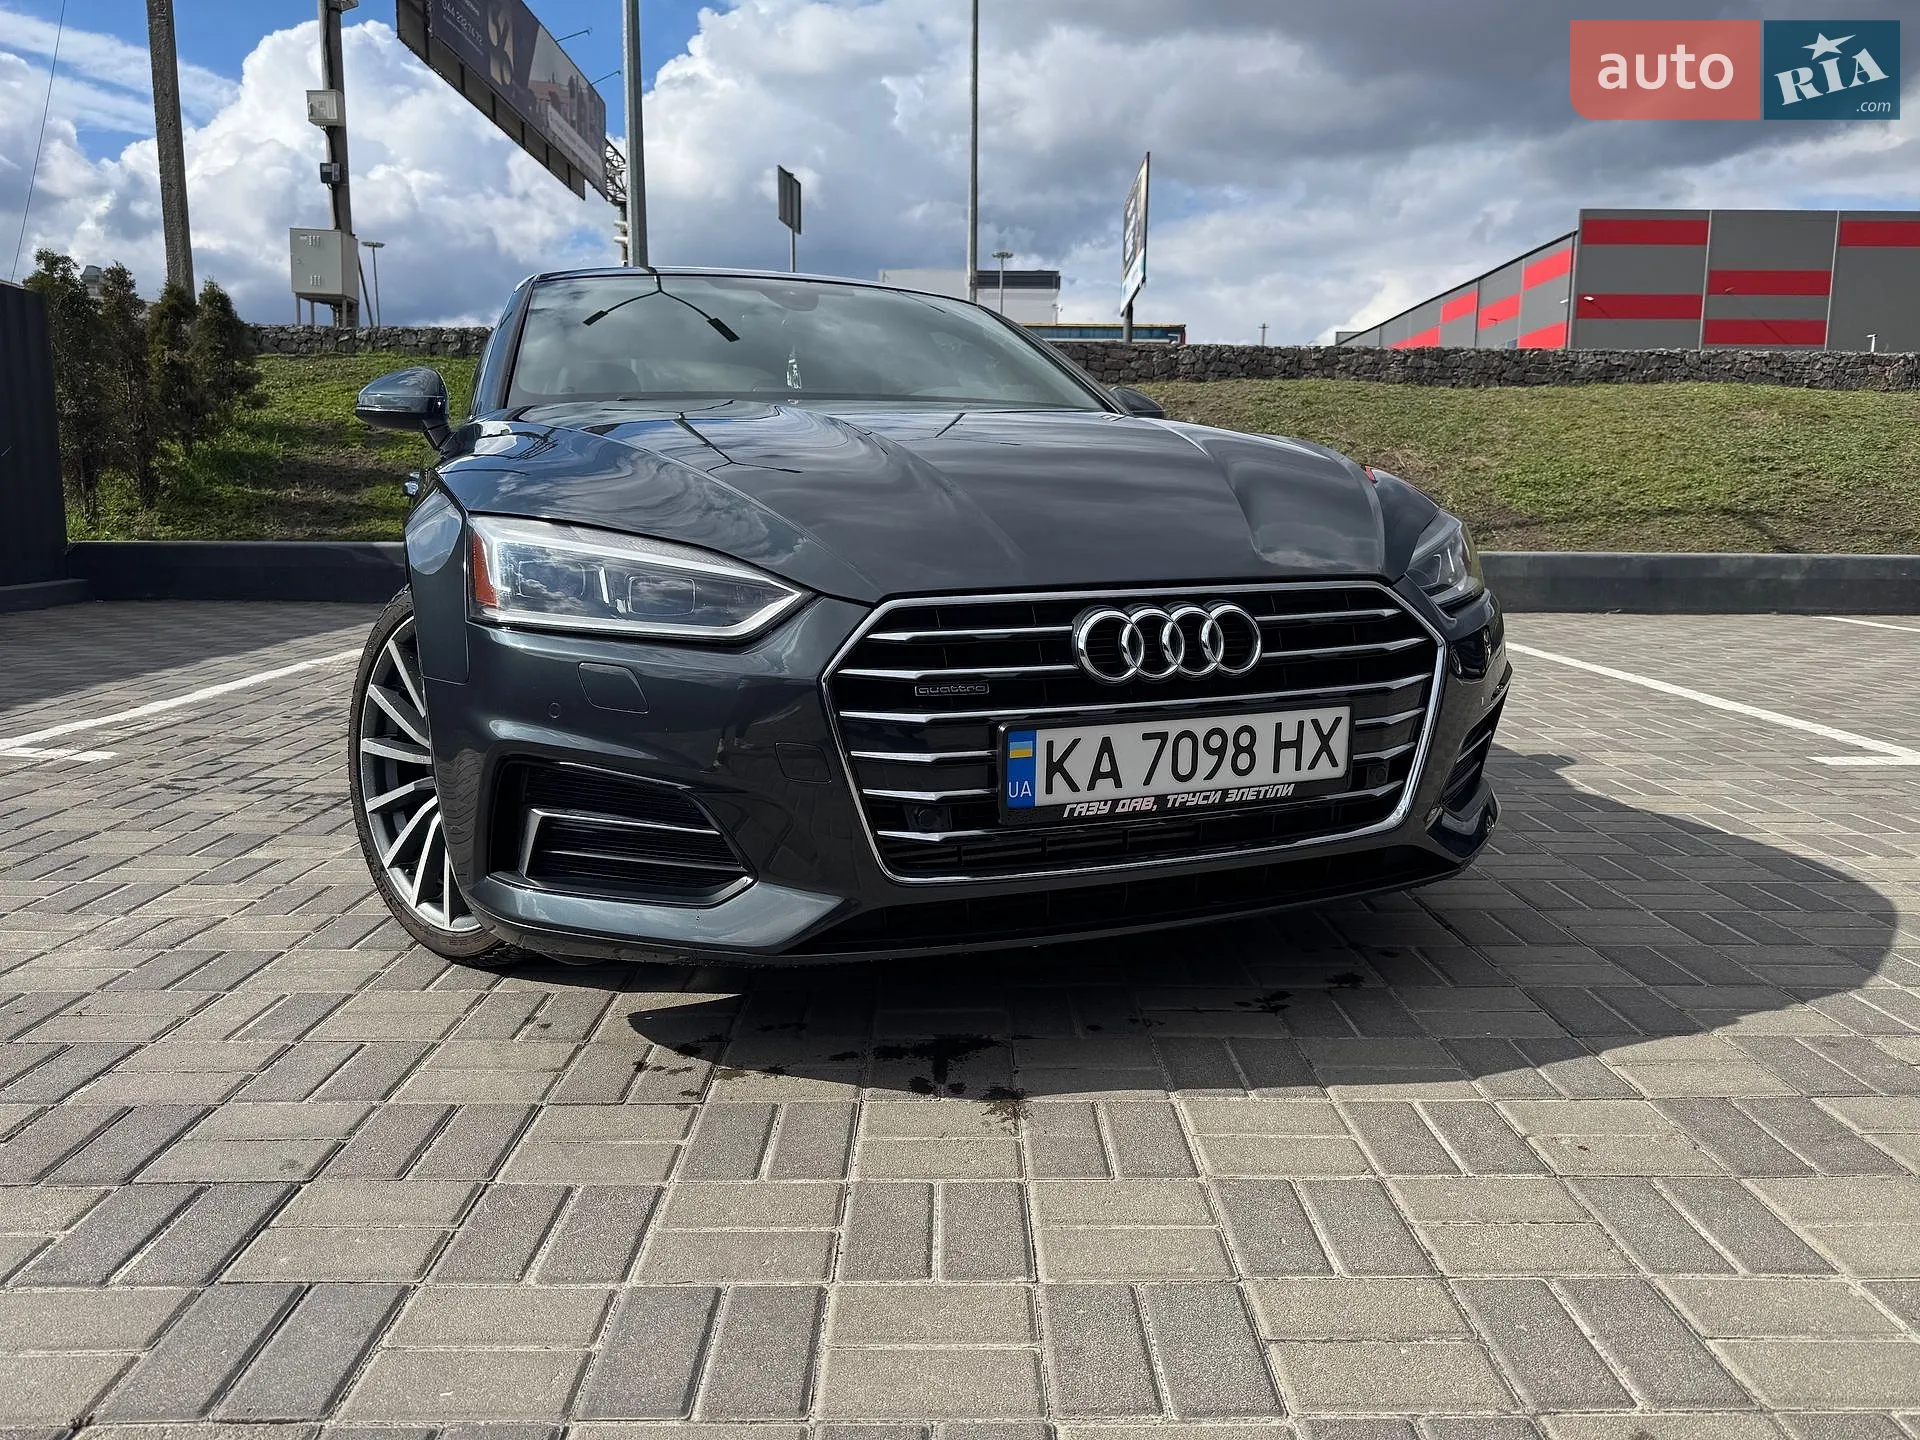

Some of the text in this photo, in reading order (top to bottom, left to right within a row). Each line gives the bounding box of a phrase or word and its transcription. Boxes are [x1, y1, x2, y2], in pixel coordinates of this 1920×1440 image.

[919, 685, 986, 695] quattro
[1045, 716, 1343, 795] KA 7098 HX
[1008, 782, 1032, 798] UA
[1063, 799, 1113, 818] ГАЗУ
[1166, 790, 1222, 808] ТРУСИ
